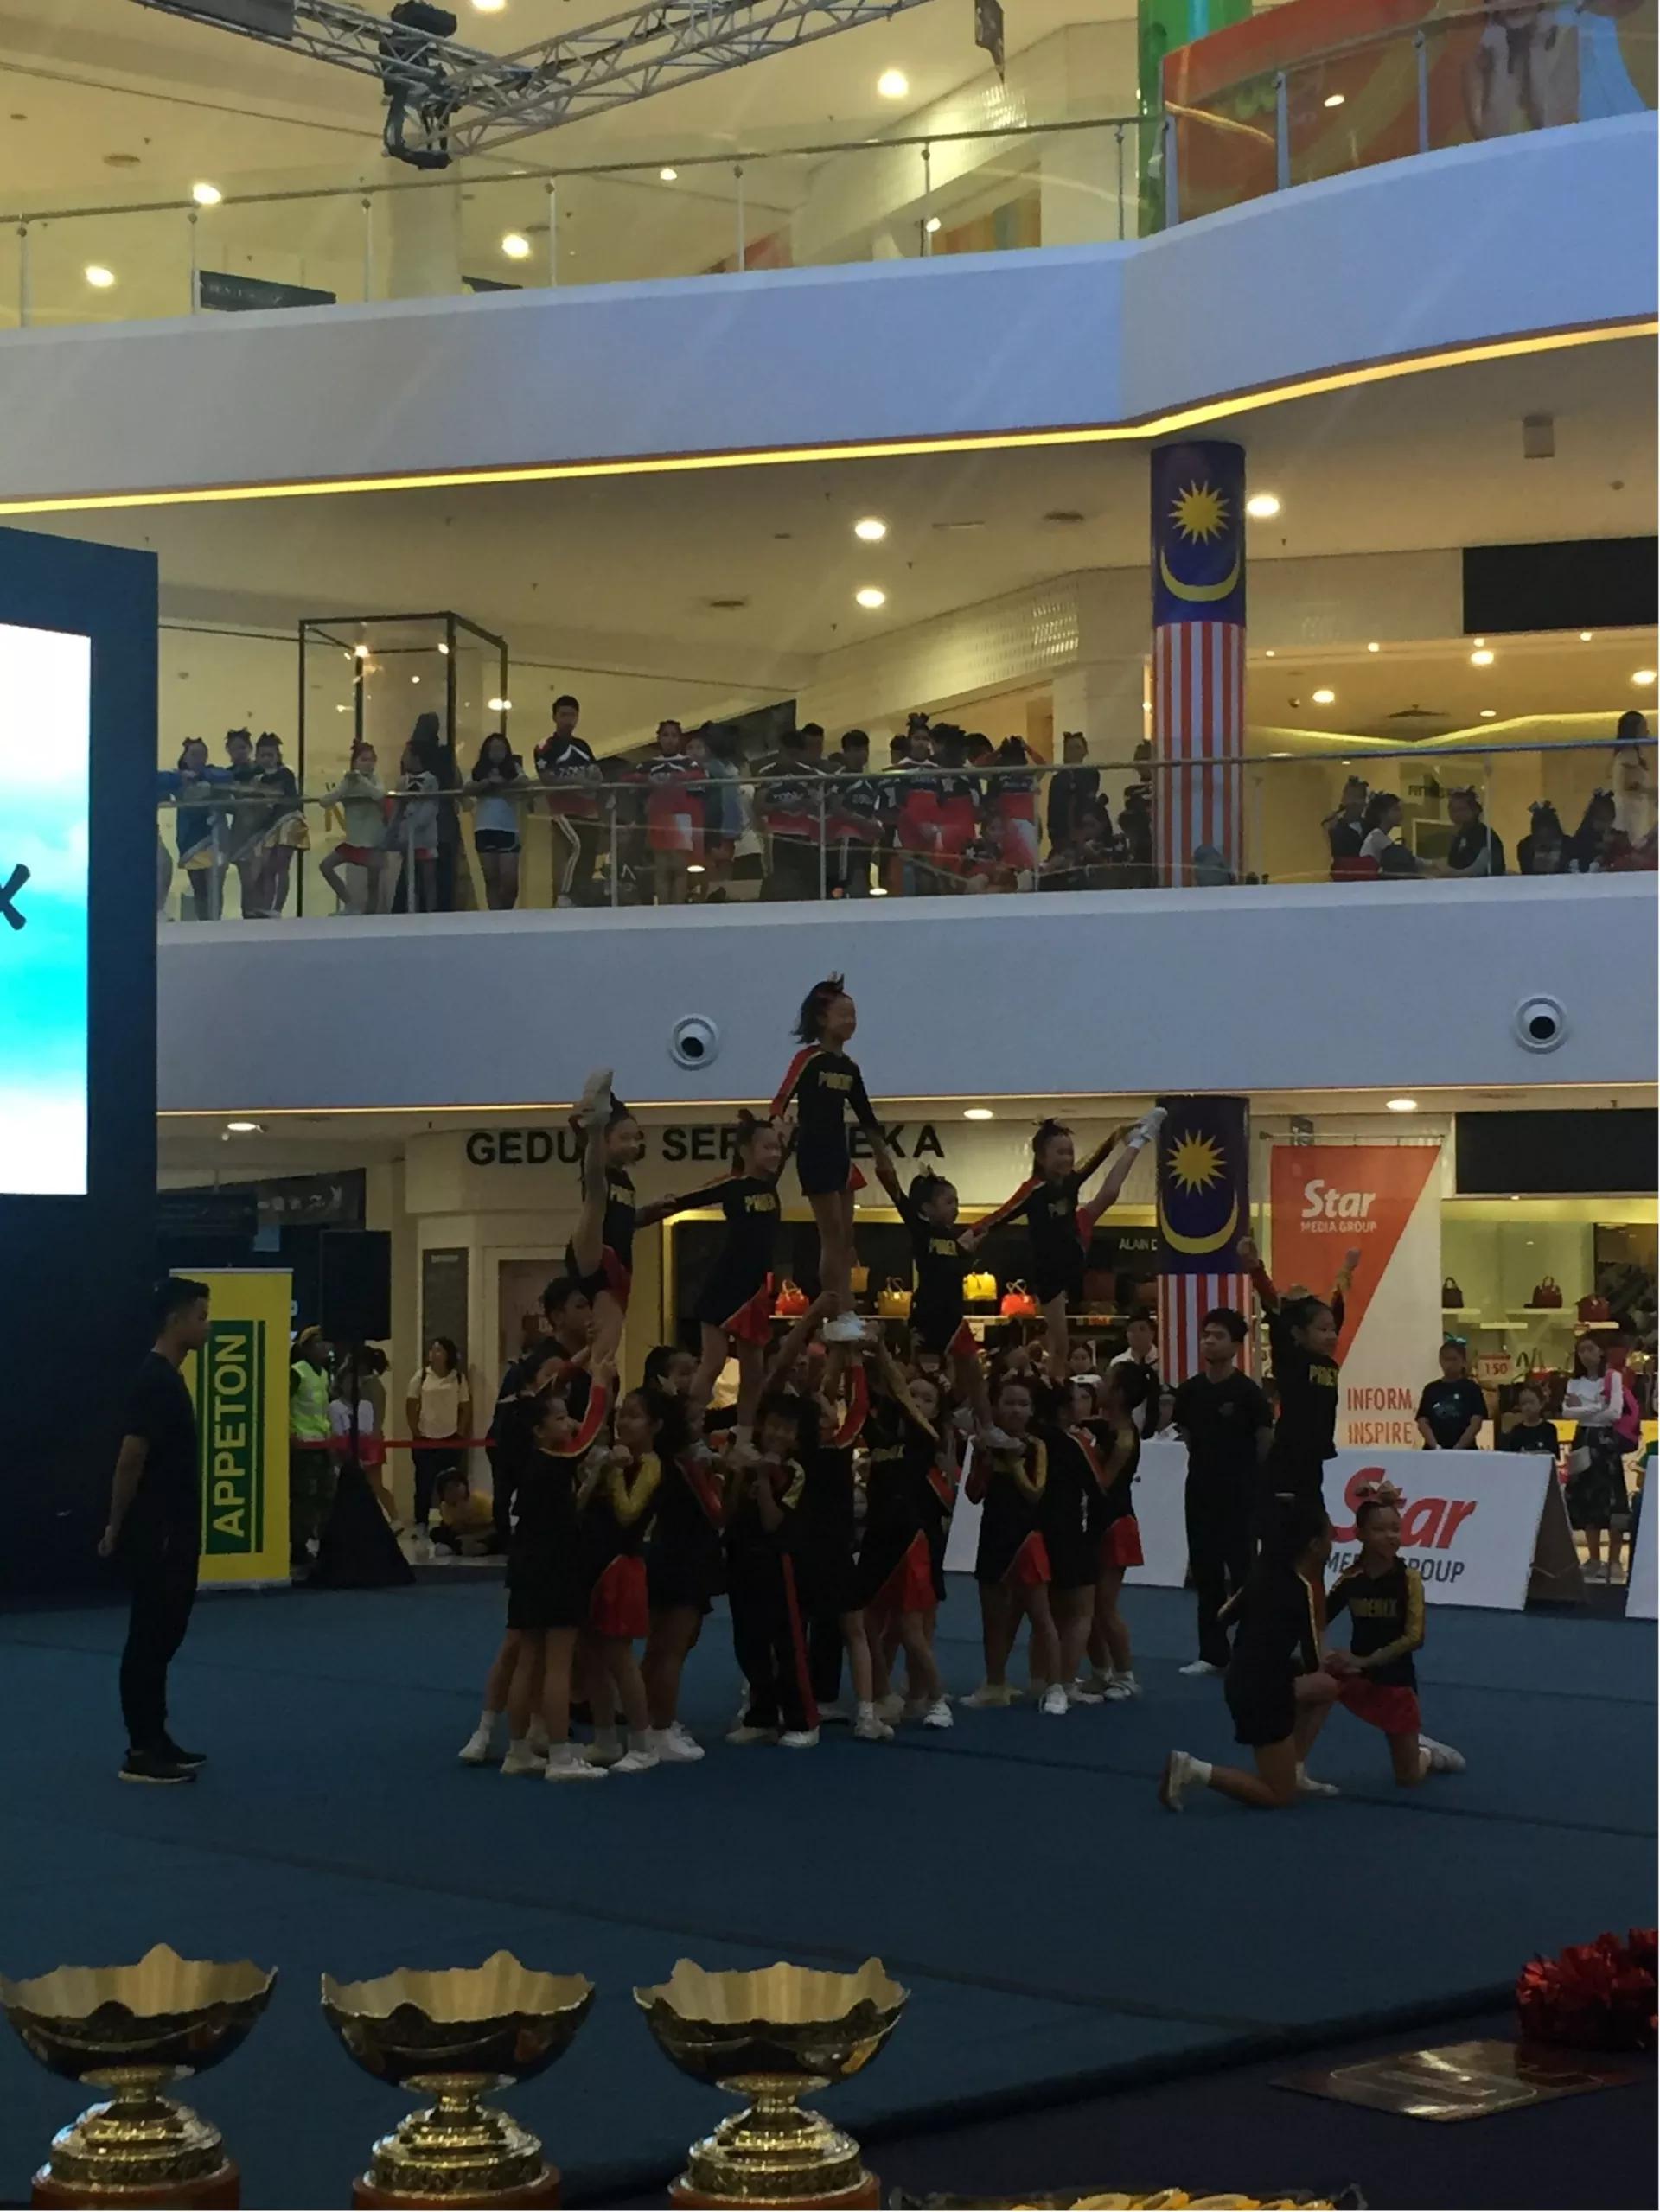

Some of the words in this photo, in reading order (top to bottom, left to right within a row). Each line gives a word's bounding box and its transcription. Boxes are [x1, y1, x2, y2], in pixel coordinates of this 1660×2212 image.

[1301, 1179, 1376, 1218] Star
[1300, 1220, 1337, 1233] MEDIA
[1339, 1220, 1377, 1233] GROUP
[1347, 1387, 1416, 1412] INFORM,
[212, 1334, 247, 1538] APPETON
[1349, 1421, 1416, 1447] INSPIRE,
